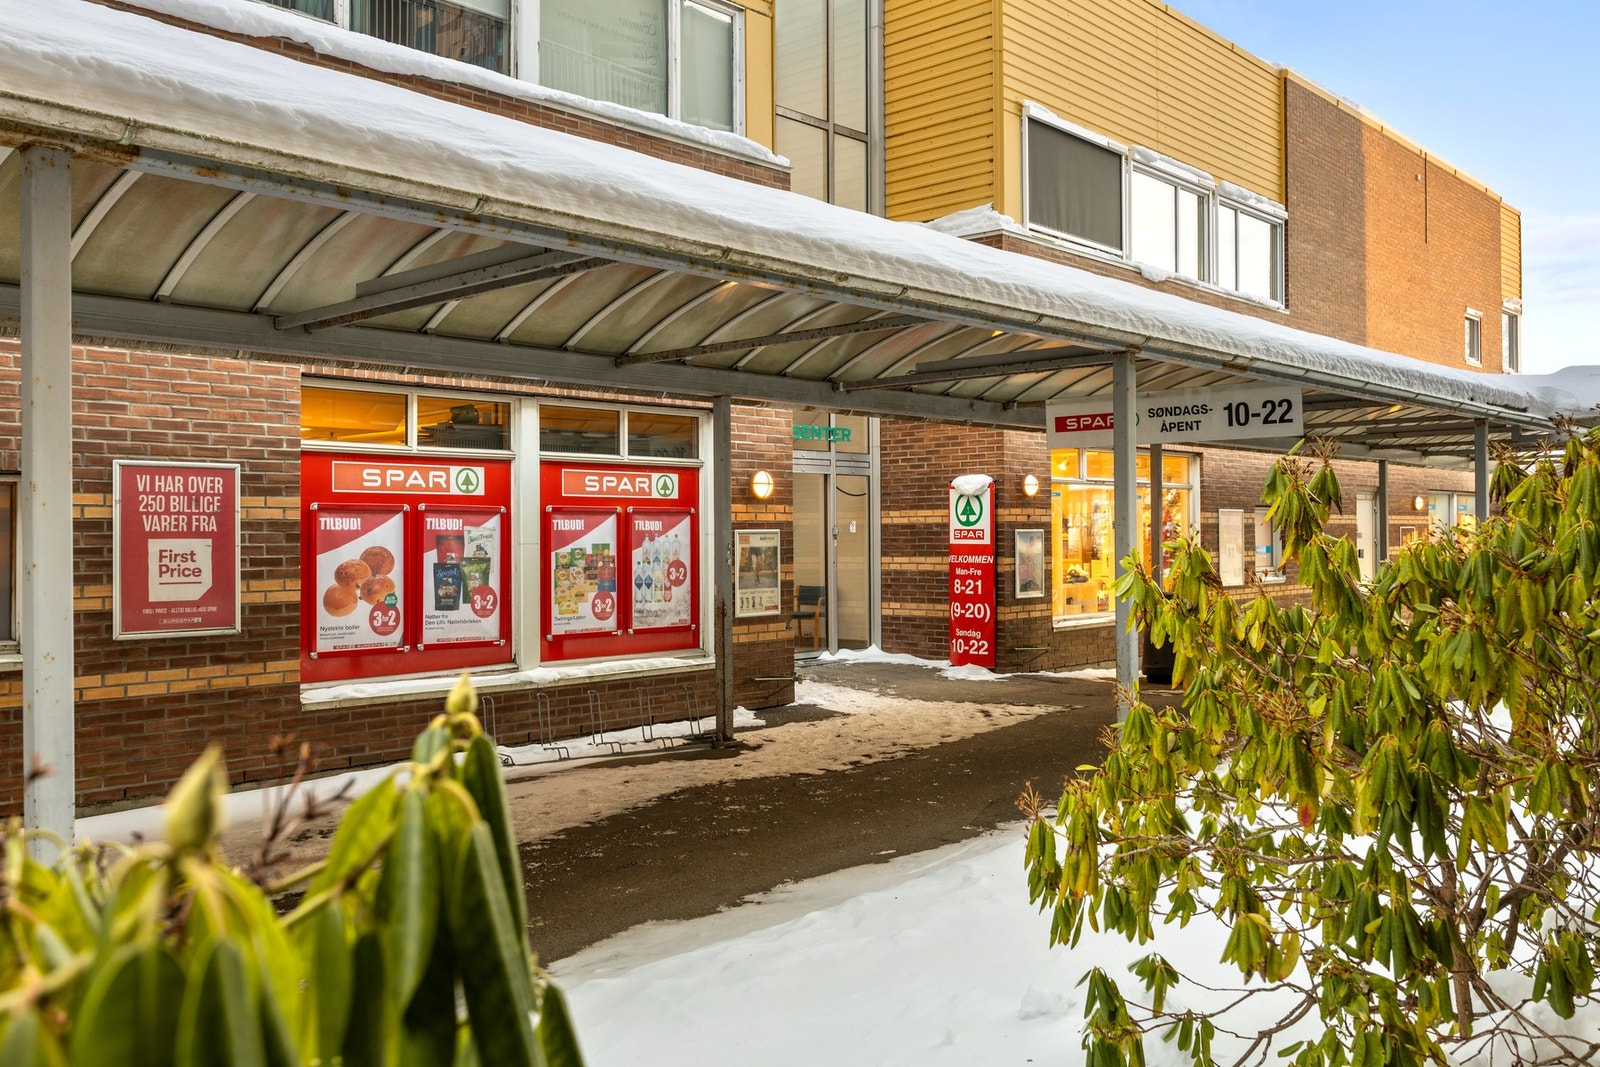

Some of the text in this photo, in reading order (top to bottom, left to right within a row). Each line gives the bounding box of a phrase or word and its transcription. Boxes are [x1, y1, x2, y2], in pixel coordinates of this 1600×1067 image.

[1147, 404, 1214, 418] SØNDAGS-
[1223, 398, 1294, 427] 10-22
[1160, 419, 1202, 433] ÅPENT
[136, 474, 223, 494] VI HAR OVER
[362, 468, 447, 488] SPAR
[584, 475, 650, 493] SPAR
[139, 494, 221, 513] 250 BILLIGE
[142, 514, 217, 532] VARER FRA
[319, 517, 361, 530] TILBUD!
[425, 517, 463, 531] TILBUD!
[552, 519, 585, 531] TILBUD!
[634, 520, 662, 531] TILBUD!
[954, 530, 983, 539] SPAR
[159, 549, 197, 563] First
[159, 563, 202, 578] Price
[669, 567, 676, 580] 3
[679, 567, 685, 580] 2
[955, 567, 982, 576] Man-Fre
[954, 578, 982, 595] 8-21
[474, 594, 481, 610] 3
[487, 594, 494, 609] 2
[594, 599, 601, 613] 3
[605, 598, 612, 613] 2
[373, 610, 382, 627] 3
[388, 610, 396, 626] 2
[951, 601, 990, 623] (9-20)
[955, 628, 982, 639] Søndag
[951, 638, 989, 655] 10-22
